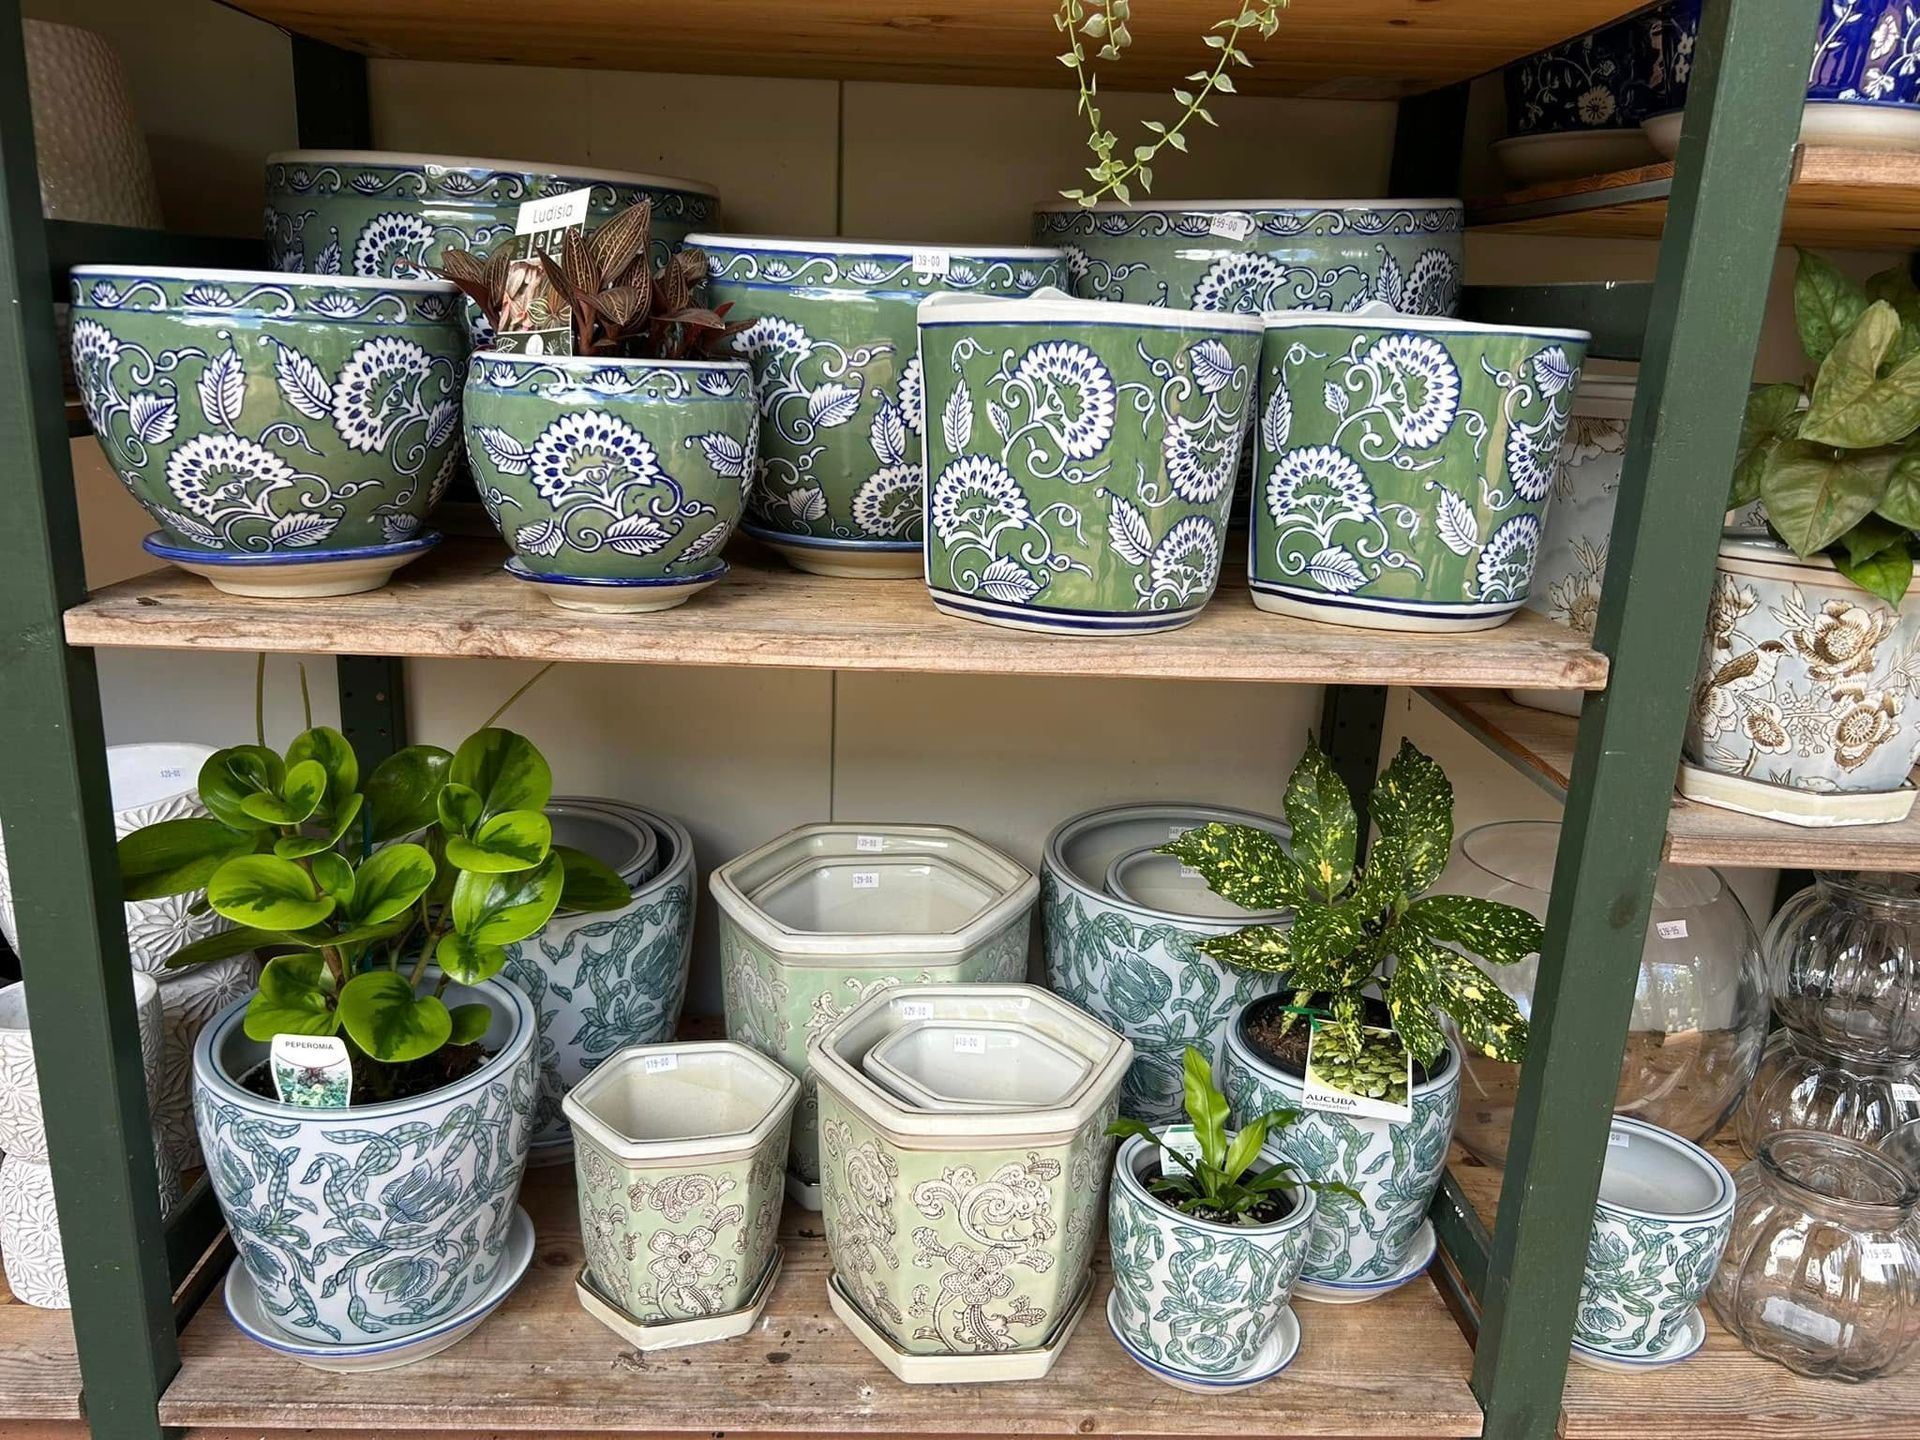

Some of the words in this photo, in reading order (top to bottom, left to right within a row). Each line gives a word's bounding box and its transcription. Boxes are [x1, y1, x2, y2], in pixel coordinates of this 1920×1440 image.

[533, 203, 573, 224] Ludisia
[285, 1040, 334, 1051] PEPEROMIA
[1305, 1094, 1357, 1107] AUCUBA
